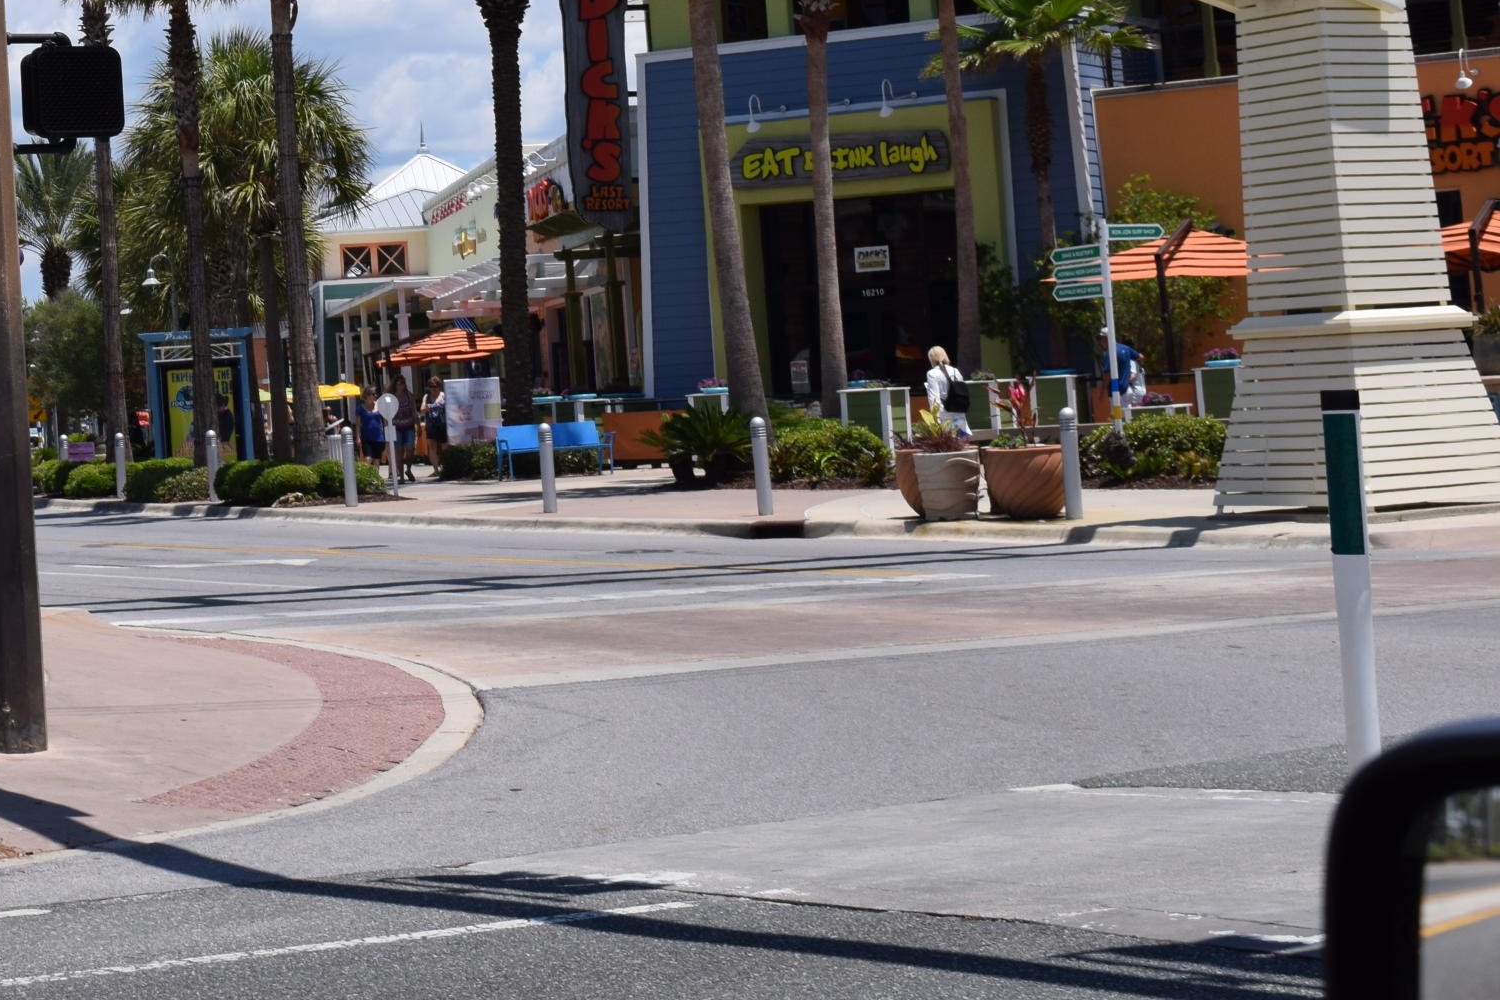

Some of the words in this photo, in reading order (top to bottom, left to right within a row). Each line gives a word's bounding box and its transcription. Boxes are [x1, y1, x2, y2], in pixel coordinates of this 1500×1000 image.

[742, 147, 800, 180] EAT
[878, 134, 939, 173] laugh
[1431, 140, 1494, 173] SORT
[585, 196, 630, 211] RESORT
[590, 184, 624, 199] LAST
